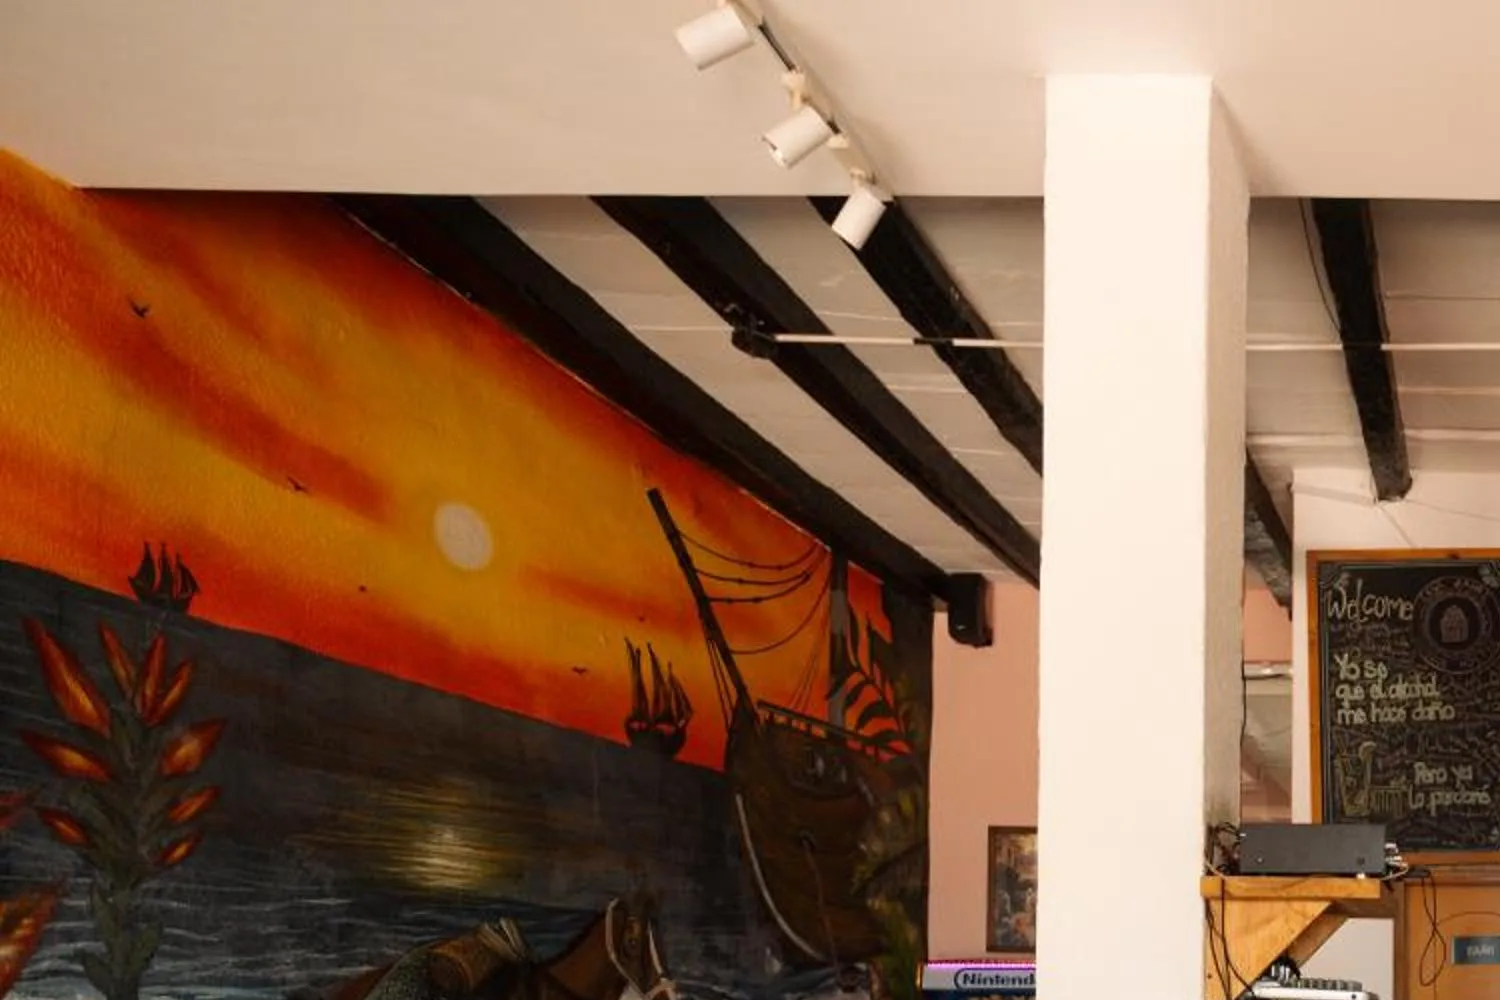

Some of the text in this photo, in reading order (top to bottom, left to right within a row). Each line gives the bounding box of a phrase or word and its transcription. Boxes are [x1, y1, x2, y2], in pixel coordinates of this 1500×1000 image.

[1327, 578, 1415, 623] Welcome
[1334, 653, 1361, 680] Yo
[962, 972, 1035, 985] Nintend
